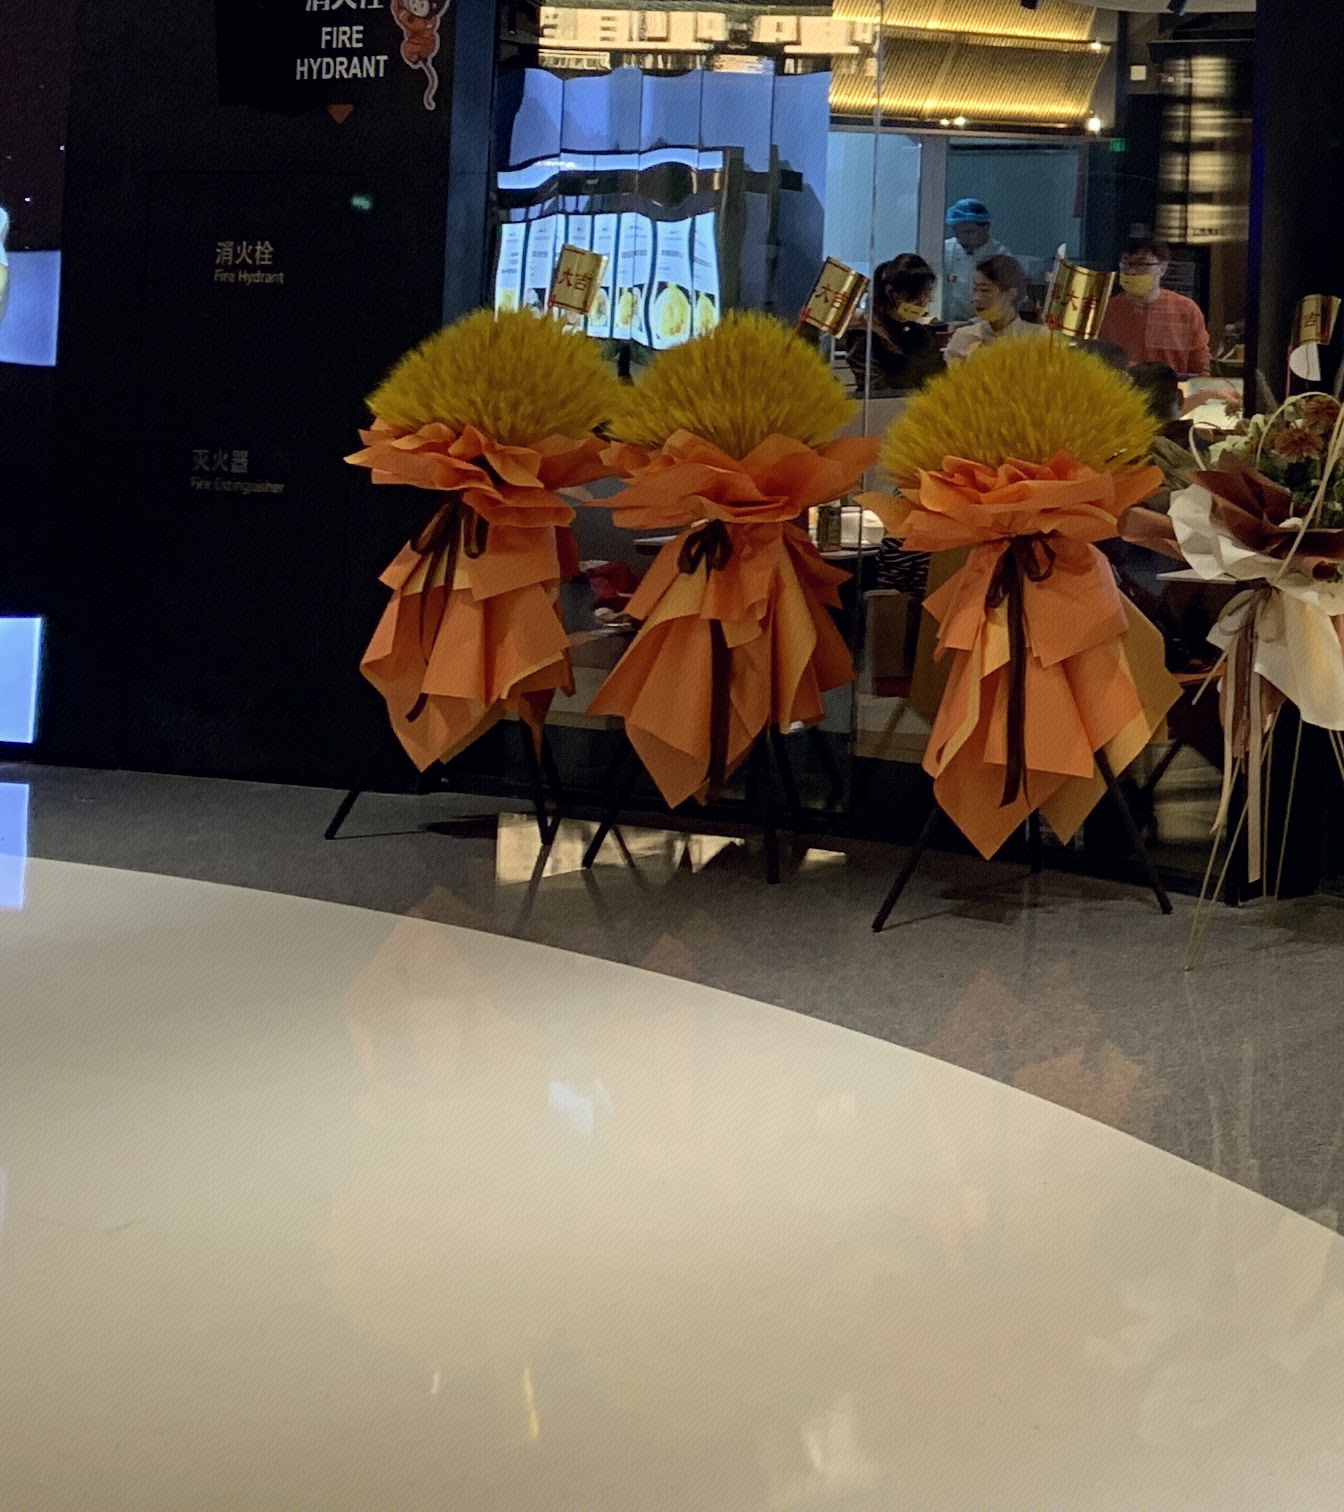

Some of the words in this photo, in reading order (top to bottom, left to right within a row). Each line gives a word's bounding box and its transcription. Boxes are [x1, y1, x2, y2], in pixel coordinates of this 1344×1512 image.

[320, 25, 364, 49] FIRE
[295, 55, 388, 80] HYDRANT
[215, 240, 274, 265] 消火栓
[213, 269, 236, 283] Fire
[238, 270, 285, 286] Hydrant
